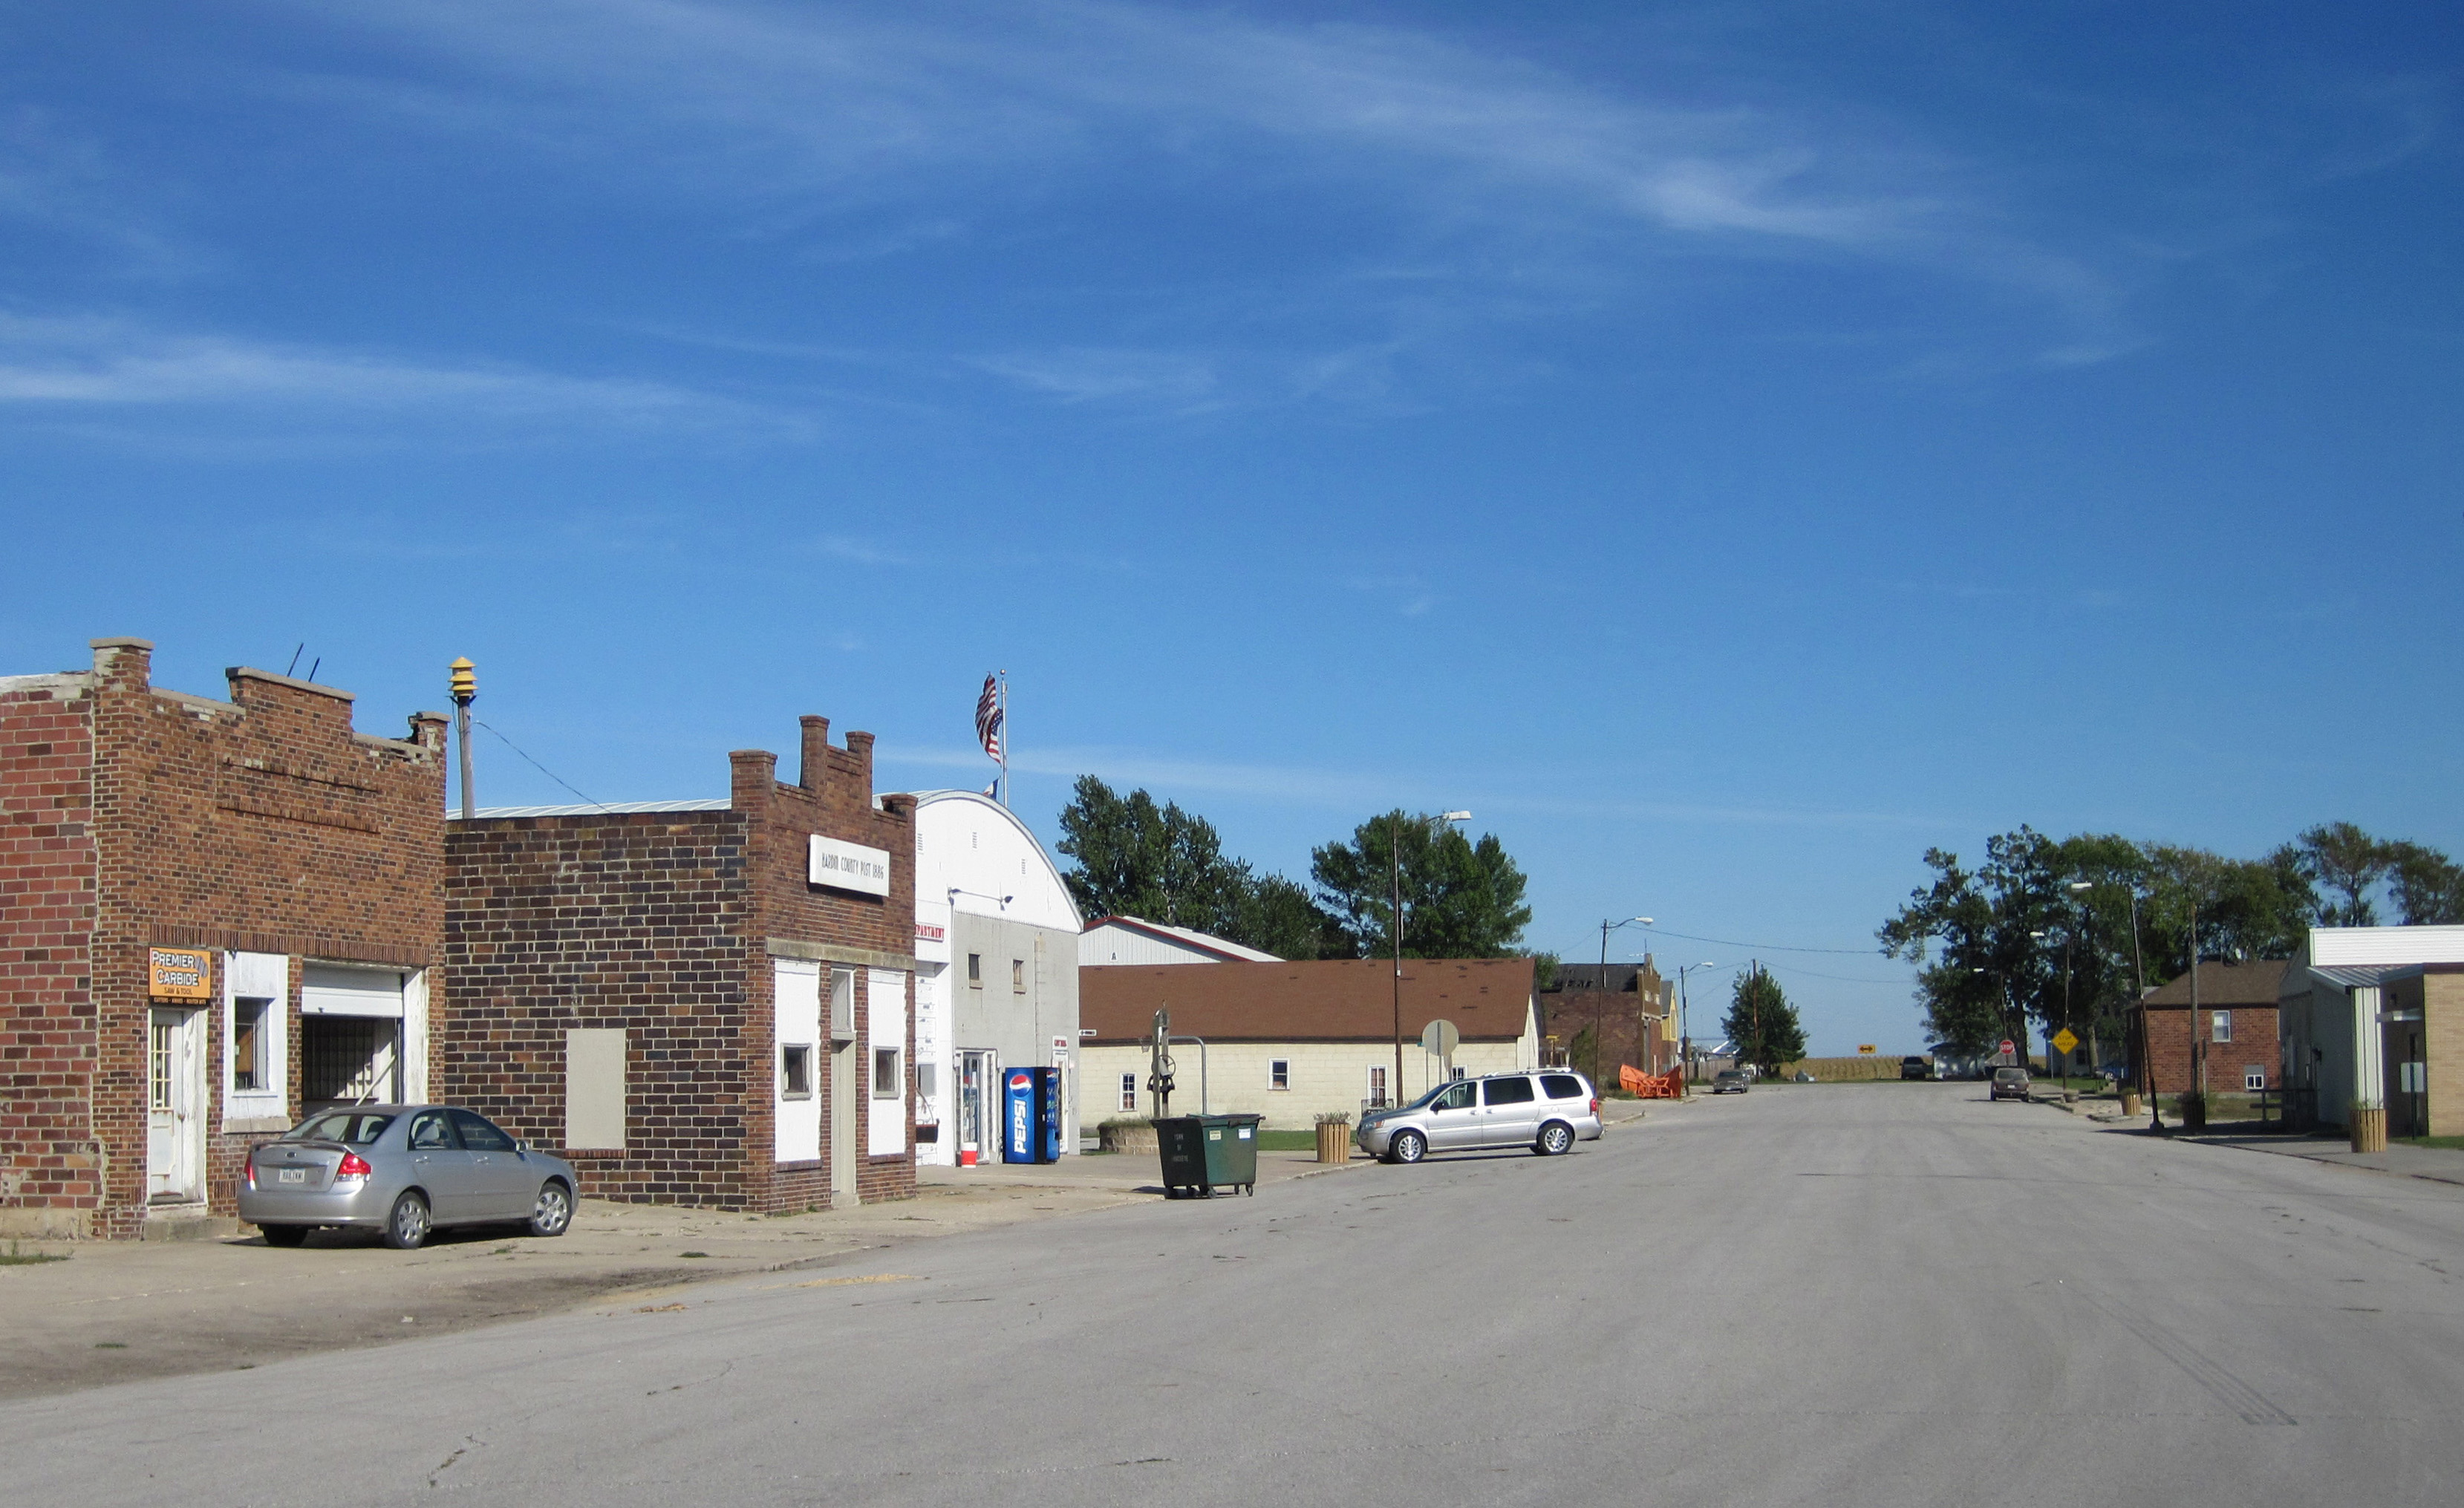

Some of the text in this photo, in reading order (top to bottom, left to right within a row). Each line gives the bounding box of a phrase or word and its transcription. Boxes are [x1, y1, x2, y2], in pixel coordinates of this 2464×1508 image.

[821, 852, 838, 870] HARDIN
[841, 856, 858, 875] COUNTY
[861, 861, 870, 877] POST
[151, 950, 195, 968] PREMIER
[156, 968, 200, 987] CARBIDE
[1014, 1099, 1027, 1155] PEPSI
